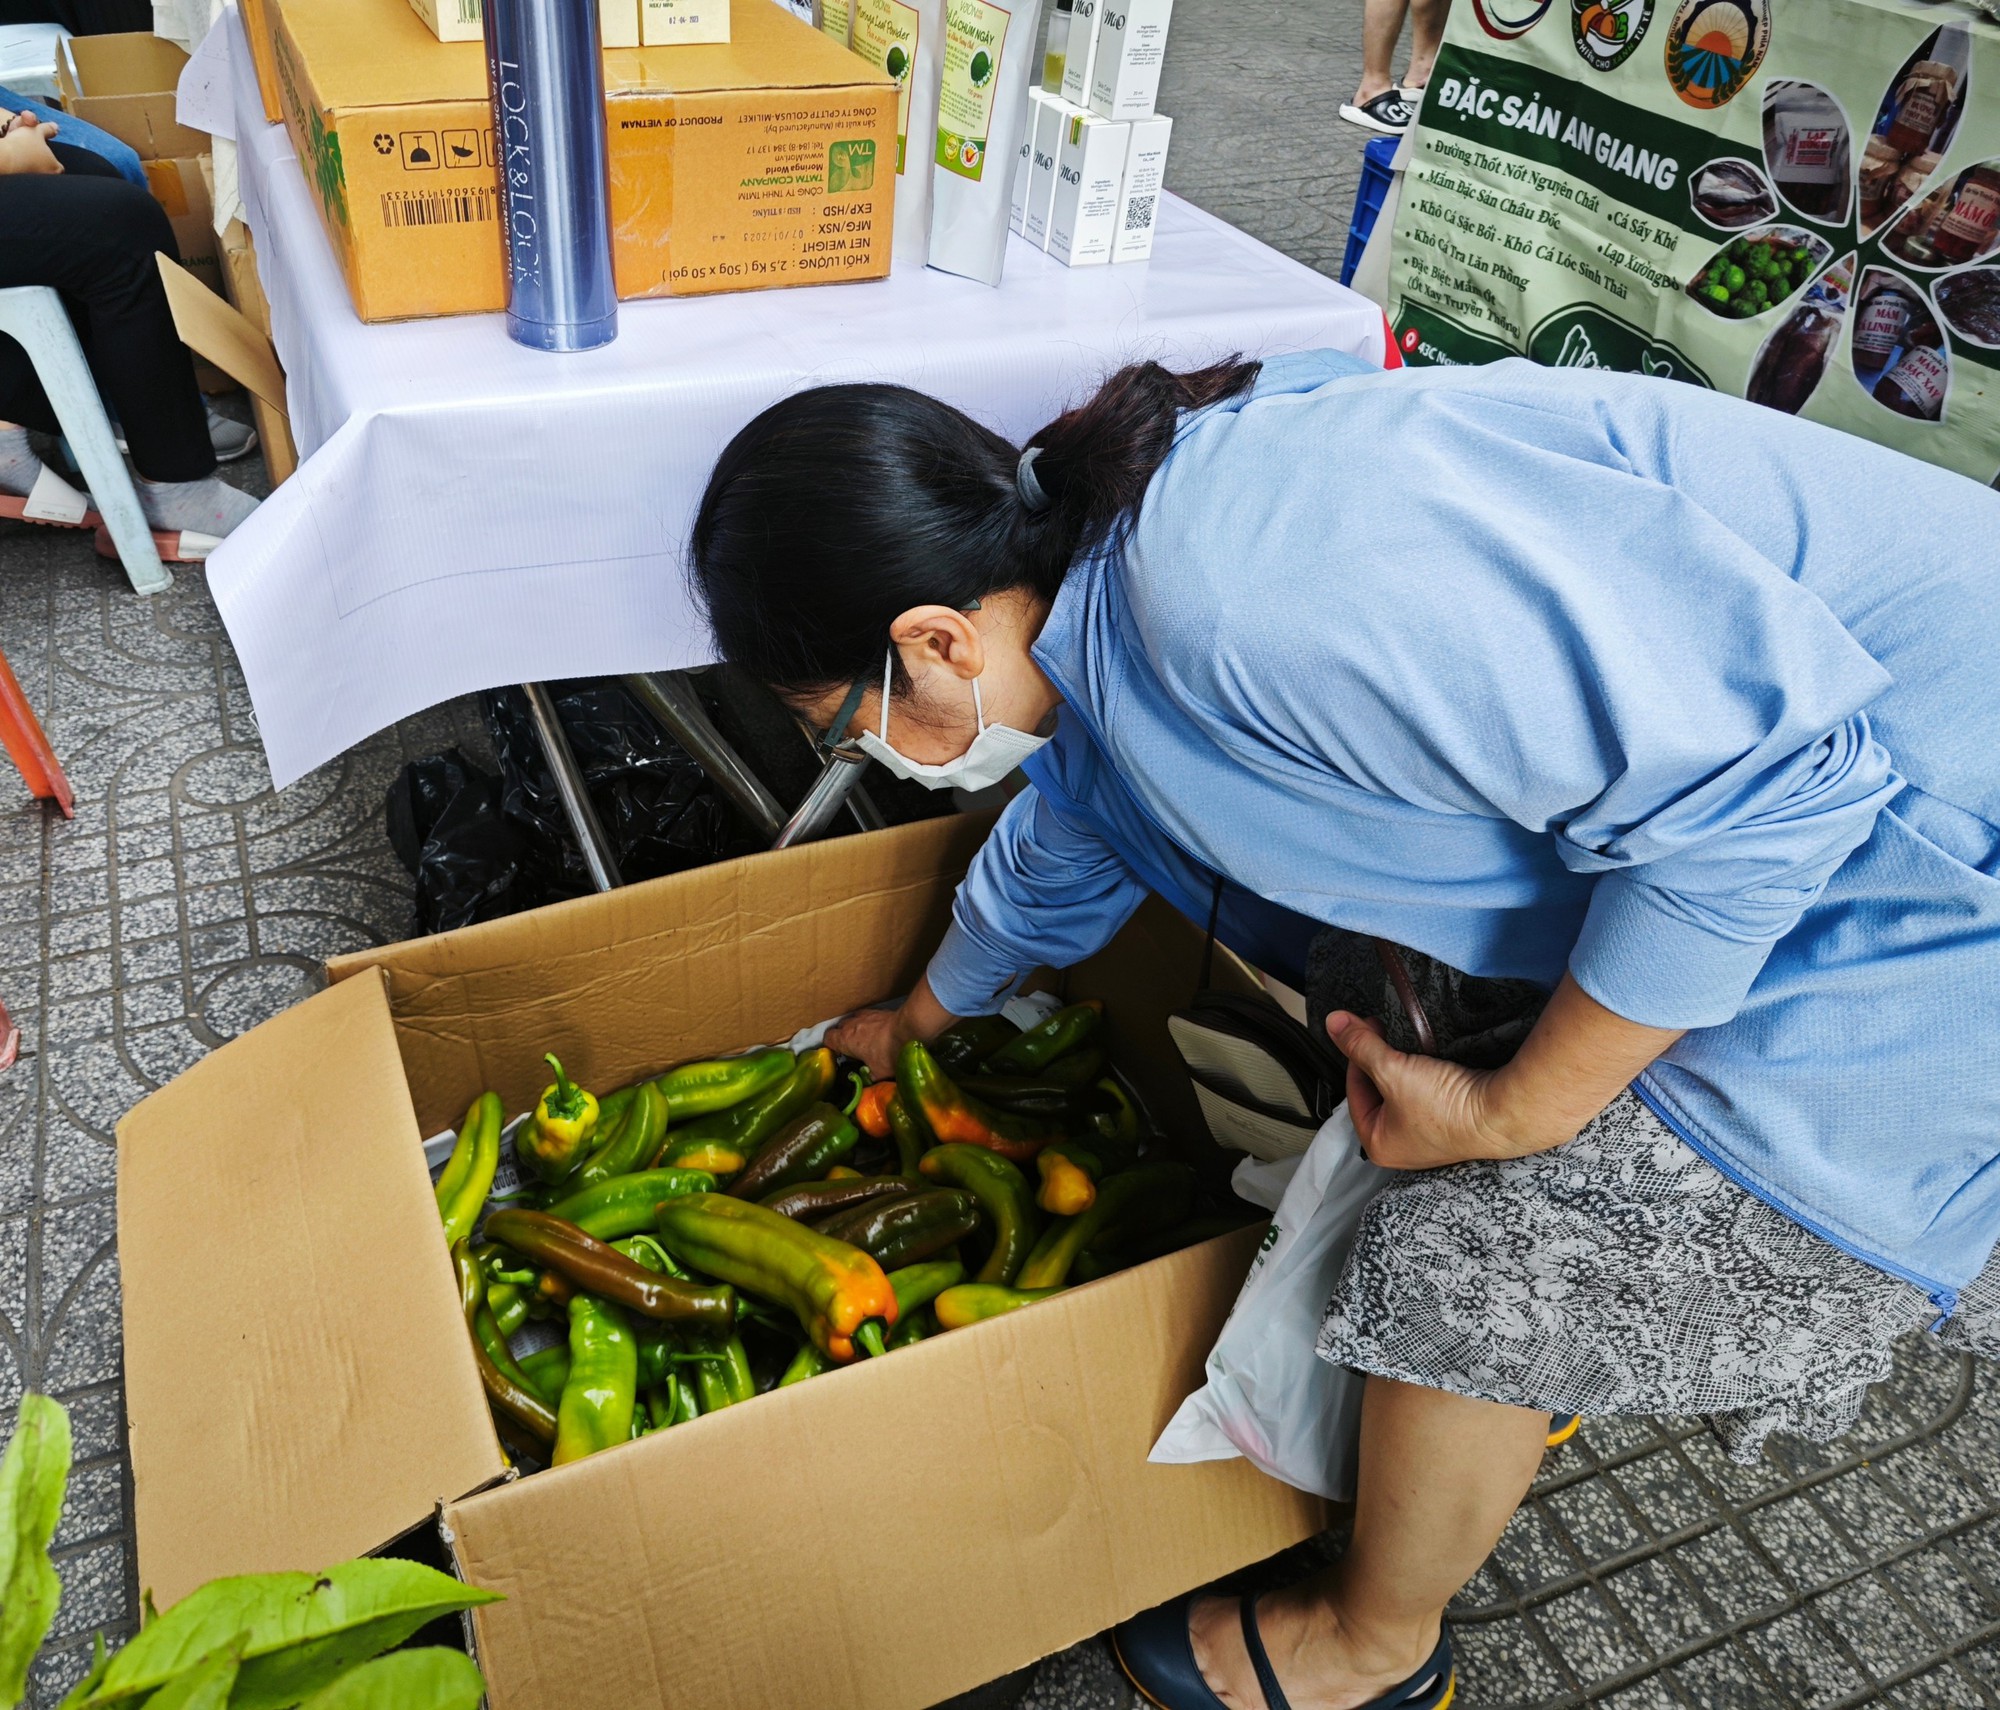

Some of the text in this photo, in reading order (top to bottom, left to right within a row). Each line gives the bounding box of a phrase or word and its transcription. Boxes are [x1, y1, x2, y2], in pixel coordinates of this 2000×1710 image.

[621, 116, 723, 129] PRODUCT OF VIETNAM
[1438, 77, 1679, 191] ĐẶC SẢN AN GIANG
[765, 162, 823, 175] Moringa World
[740, 174, 823, 187] TMTM COMPANY
[1528, 171, 1573, 196] Nguyên
[823, 203, 872, 217] EXP/HSD
[1499, 198, 1536, 220] Châu
[818, 219, 872, 234] MFG/NSX
[1613, 211, 1630, 229] Cá
[802, 236, 871, 253] NET WEIGHT
[1413, 228, 1436, 248] Khô
[1419, 199, 1442, 218] Khô
[1443, 208, 1456, 225] Cá
[1503, 234, 1533, 255] Khô
[1535, 244, 1555, 262] Cá
[1555, 251, 1577, 272] Lóc
[1578, 261, 1602, 285] Sinh
[752, 261, 767, 273] Kg
[770, 260, 787, 272] 2,5
[799, 255, 840, 270] LƯỢNG
[843, 254, 870, 270] KHỐI
[691, 267, 706, 279] 50
[1417, 341, 1438, 360] 43C
